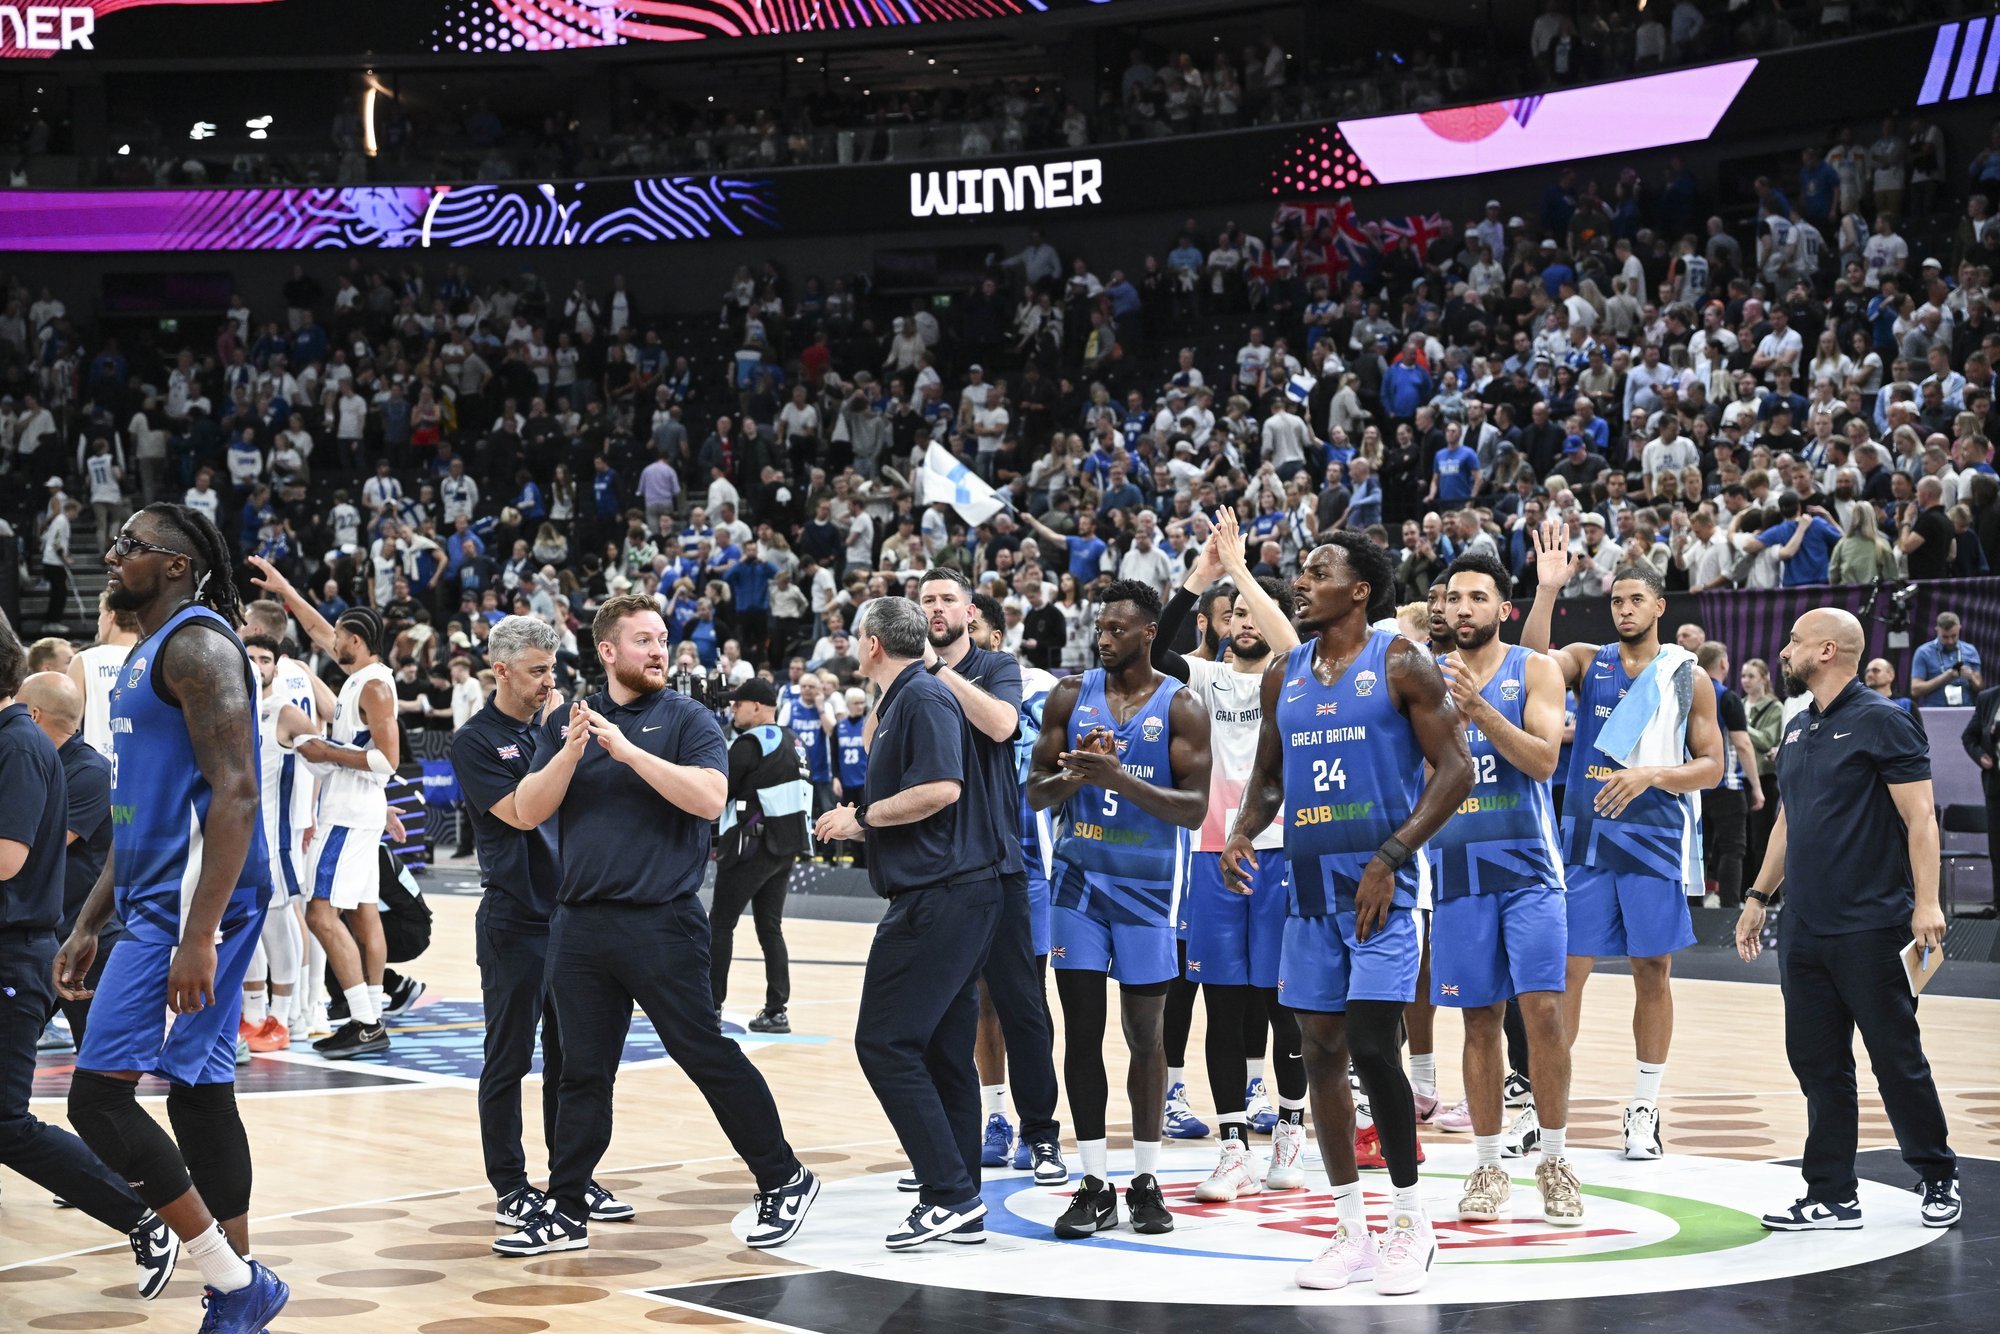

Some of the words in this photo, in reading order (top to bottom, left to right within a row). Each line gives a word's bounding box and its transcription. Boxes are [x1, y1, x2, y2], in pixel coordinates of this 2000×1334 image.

[0, 5, 95, 50] NER
[910, 158, 1102, 218] WINNER
[1594, 704, 1612, 718] GRE
[1291, 730, 1324, 747] GREAT
[1326, 725, 1366, 744] BRITAIN
[1312, 757, 1347, 793] 24
[1102, 788, 1119, 817] 5
[1294, 800, 1375, 828] SUBWAY
[1073, 821, 1150, 846] SUBWAY
